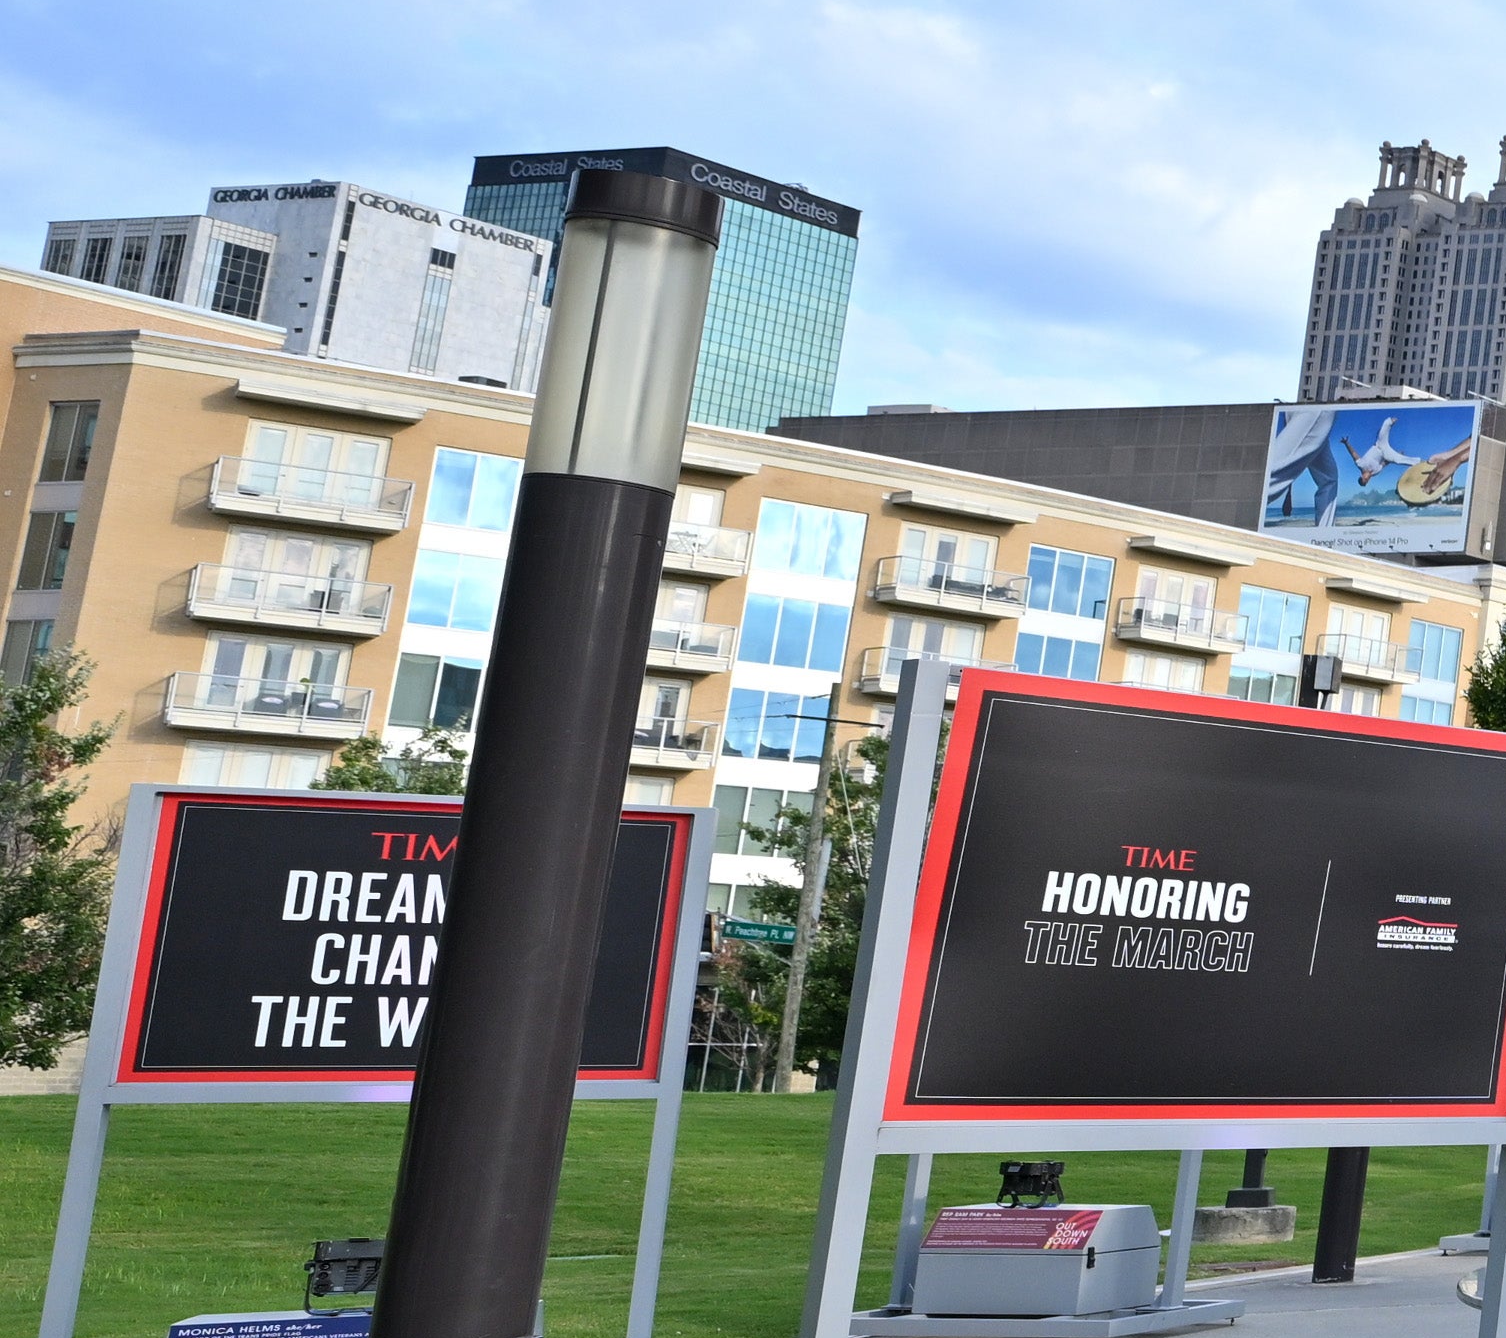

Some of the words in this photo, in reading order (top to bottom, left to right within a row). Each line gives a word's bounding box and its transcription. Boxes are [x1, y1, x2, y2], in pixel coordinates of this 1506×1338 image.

[509, 158, 567, 177] Coastal
[578, 157, 624, 171] States
[213, 188, 268, 202] GEORGIA
[275, 185, 336, 200] CHAMBER
[691, 163, 766, 201] Coastal
[779, 190, 837, 225] States
[358, 192, 441, 226] GEORGIA
[449, 219, 534, 252] CHAMBER
[371, 832, 458, 861] TIM
[1121, 846, 1197, 871] TIME
[1042, 871, 1250, 923] HONORING
[1395, 894, 1427, 904] PRESENTING
[1428, 897, 1451, 905] PARTNER
[735, 926, 767, 937] Peachtree
[1379, 925, 1423, 934] AMERICAN
[1426, 927, 1456, 935] FAMILY
[1024, 921, 1103, 966] THE
[1112, 925, 1254, 972] MARCH
[251, 996, 353, 1047] THE
[1056, 1222, 1076, 1230] OUT
[1048, 1237, 1080, 1245] SOUTH
[178, 1327, 234, 1336] MONICA
[239, 1324, 281, 1333] HELMS
